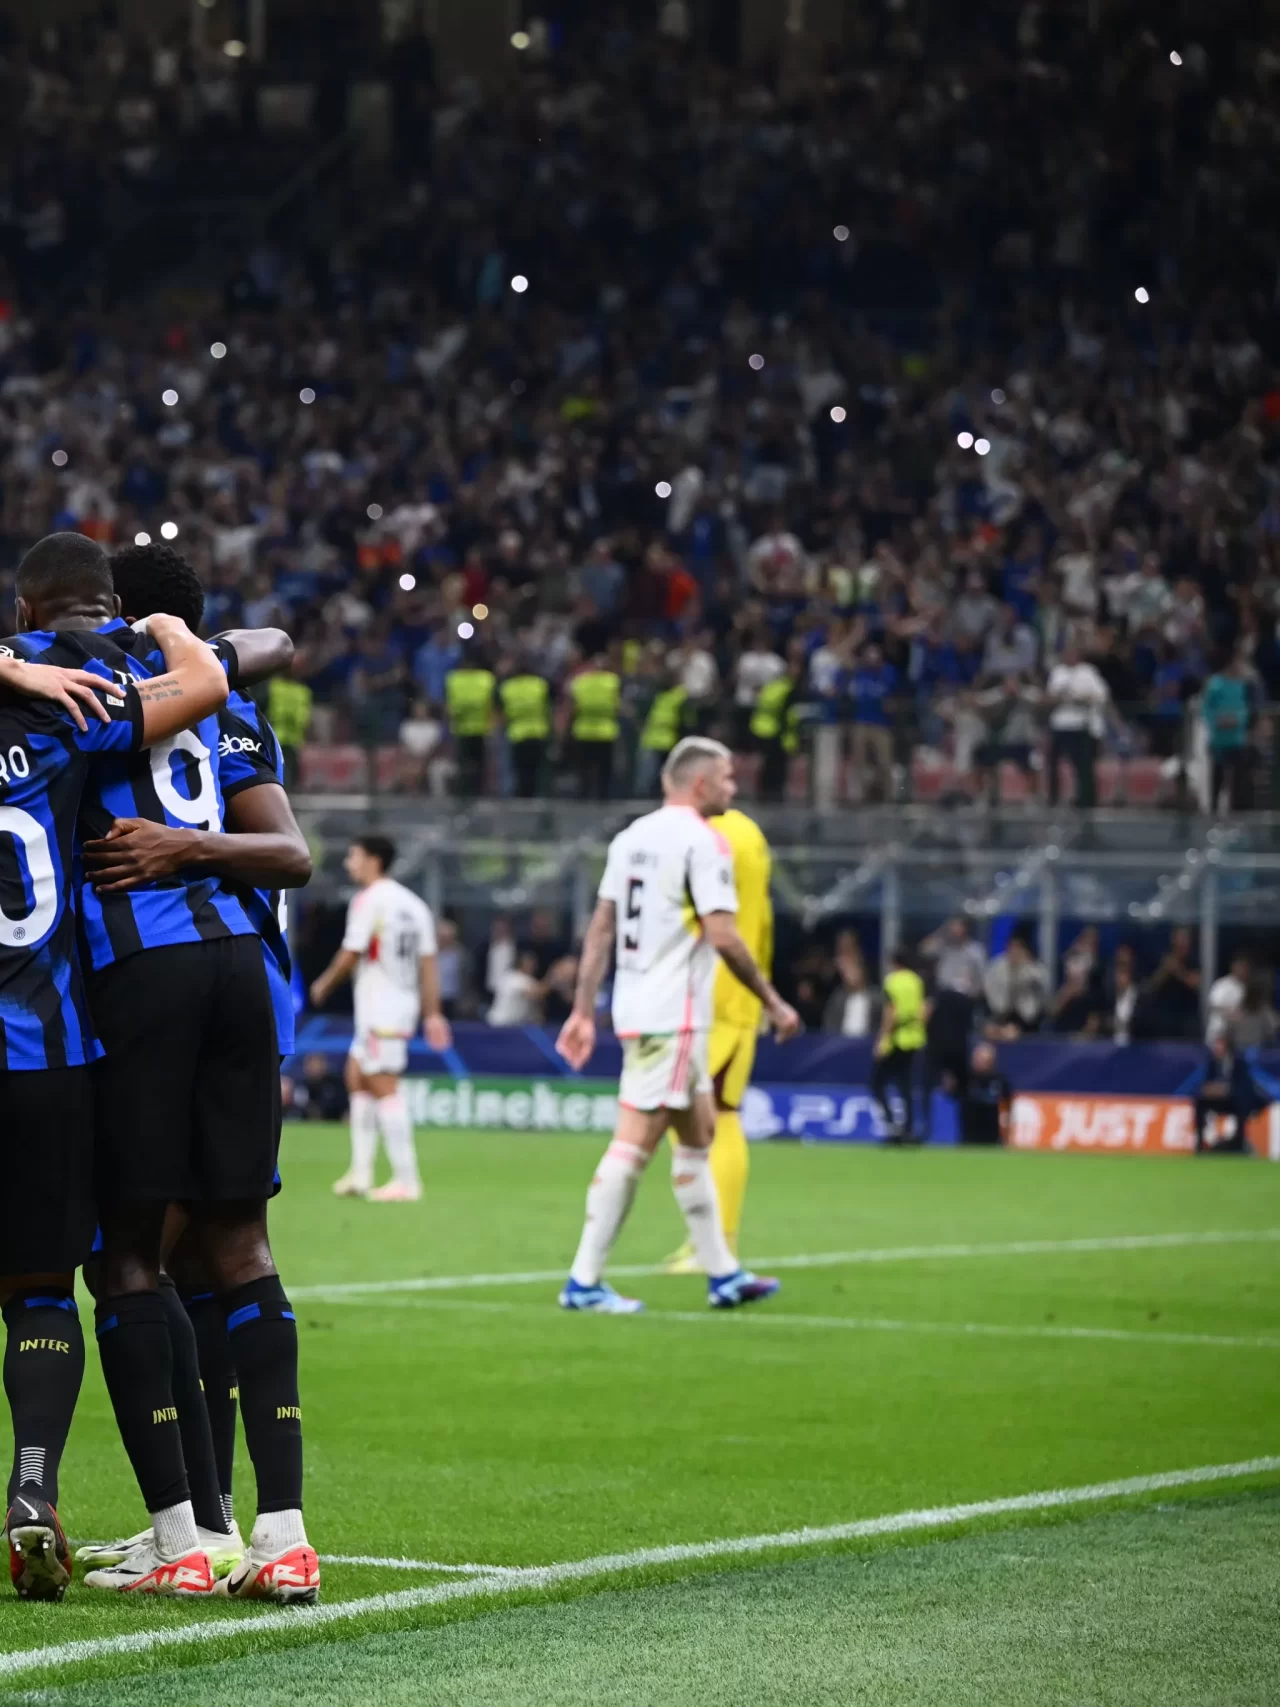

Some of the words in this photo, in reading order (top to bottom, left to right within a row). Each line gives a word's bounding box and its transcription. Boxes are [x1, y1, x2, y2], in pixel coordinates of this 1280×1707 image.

[150, 729, 221, 833] 9
[1052, 1101, 1157, 1149] JUST
[19, 1338, 70, 1354] INTER
[152, 1406, 179, 1425] INTE
[276, 1406, 302, 1420] INTE
